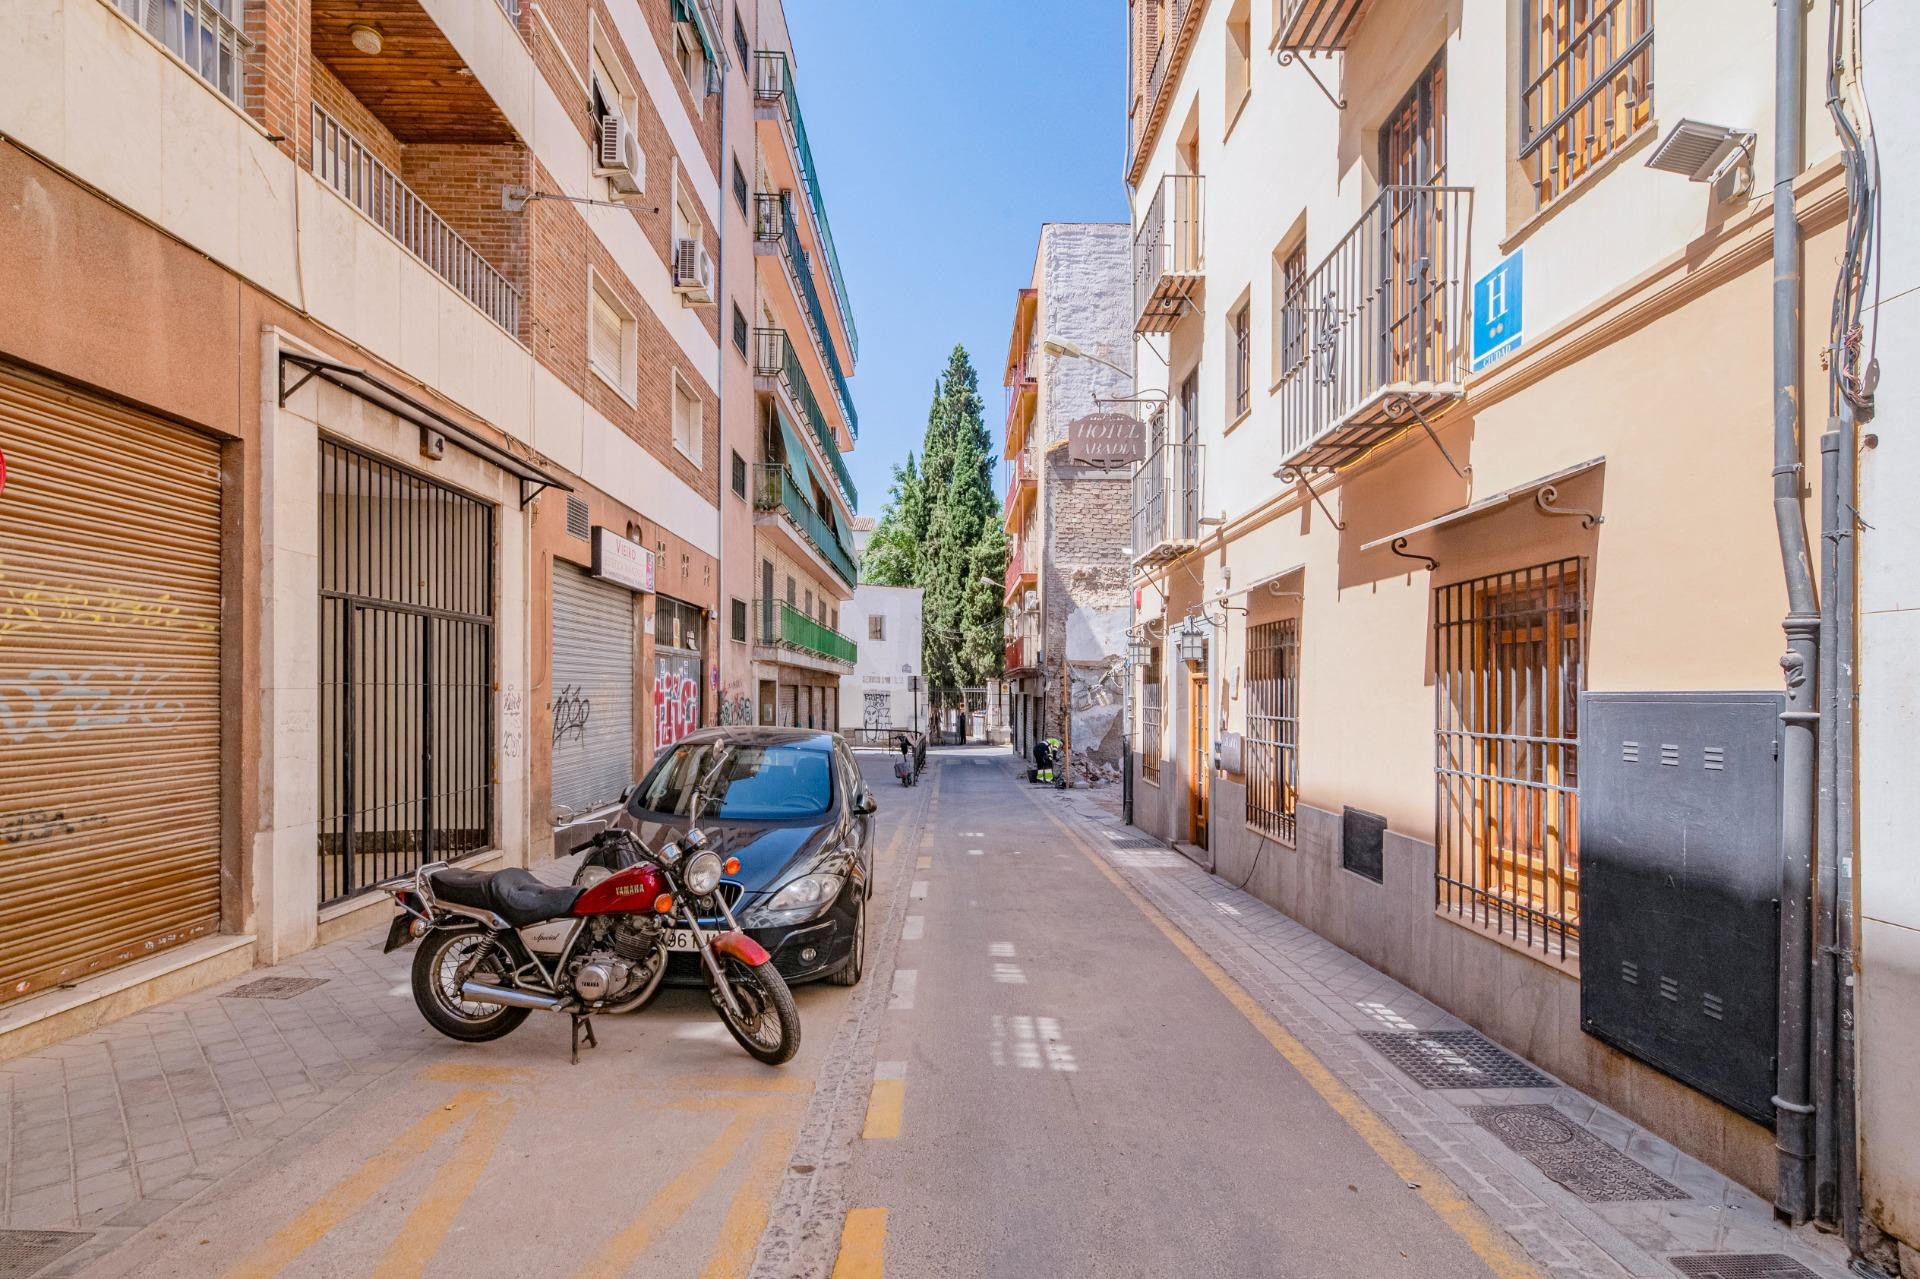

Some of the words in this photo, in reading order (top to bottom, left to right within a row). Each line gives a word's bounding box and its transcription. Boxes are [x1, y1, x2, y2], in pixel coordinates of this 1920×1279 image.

[1486, 267, 1509, 326] H
[1077, 423, 1140, 439] HOTEL
[435, 437, 444, 453] 4
[615, 884, 645, 896] YAMAHA
